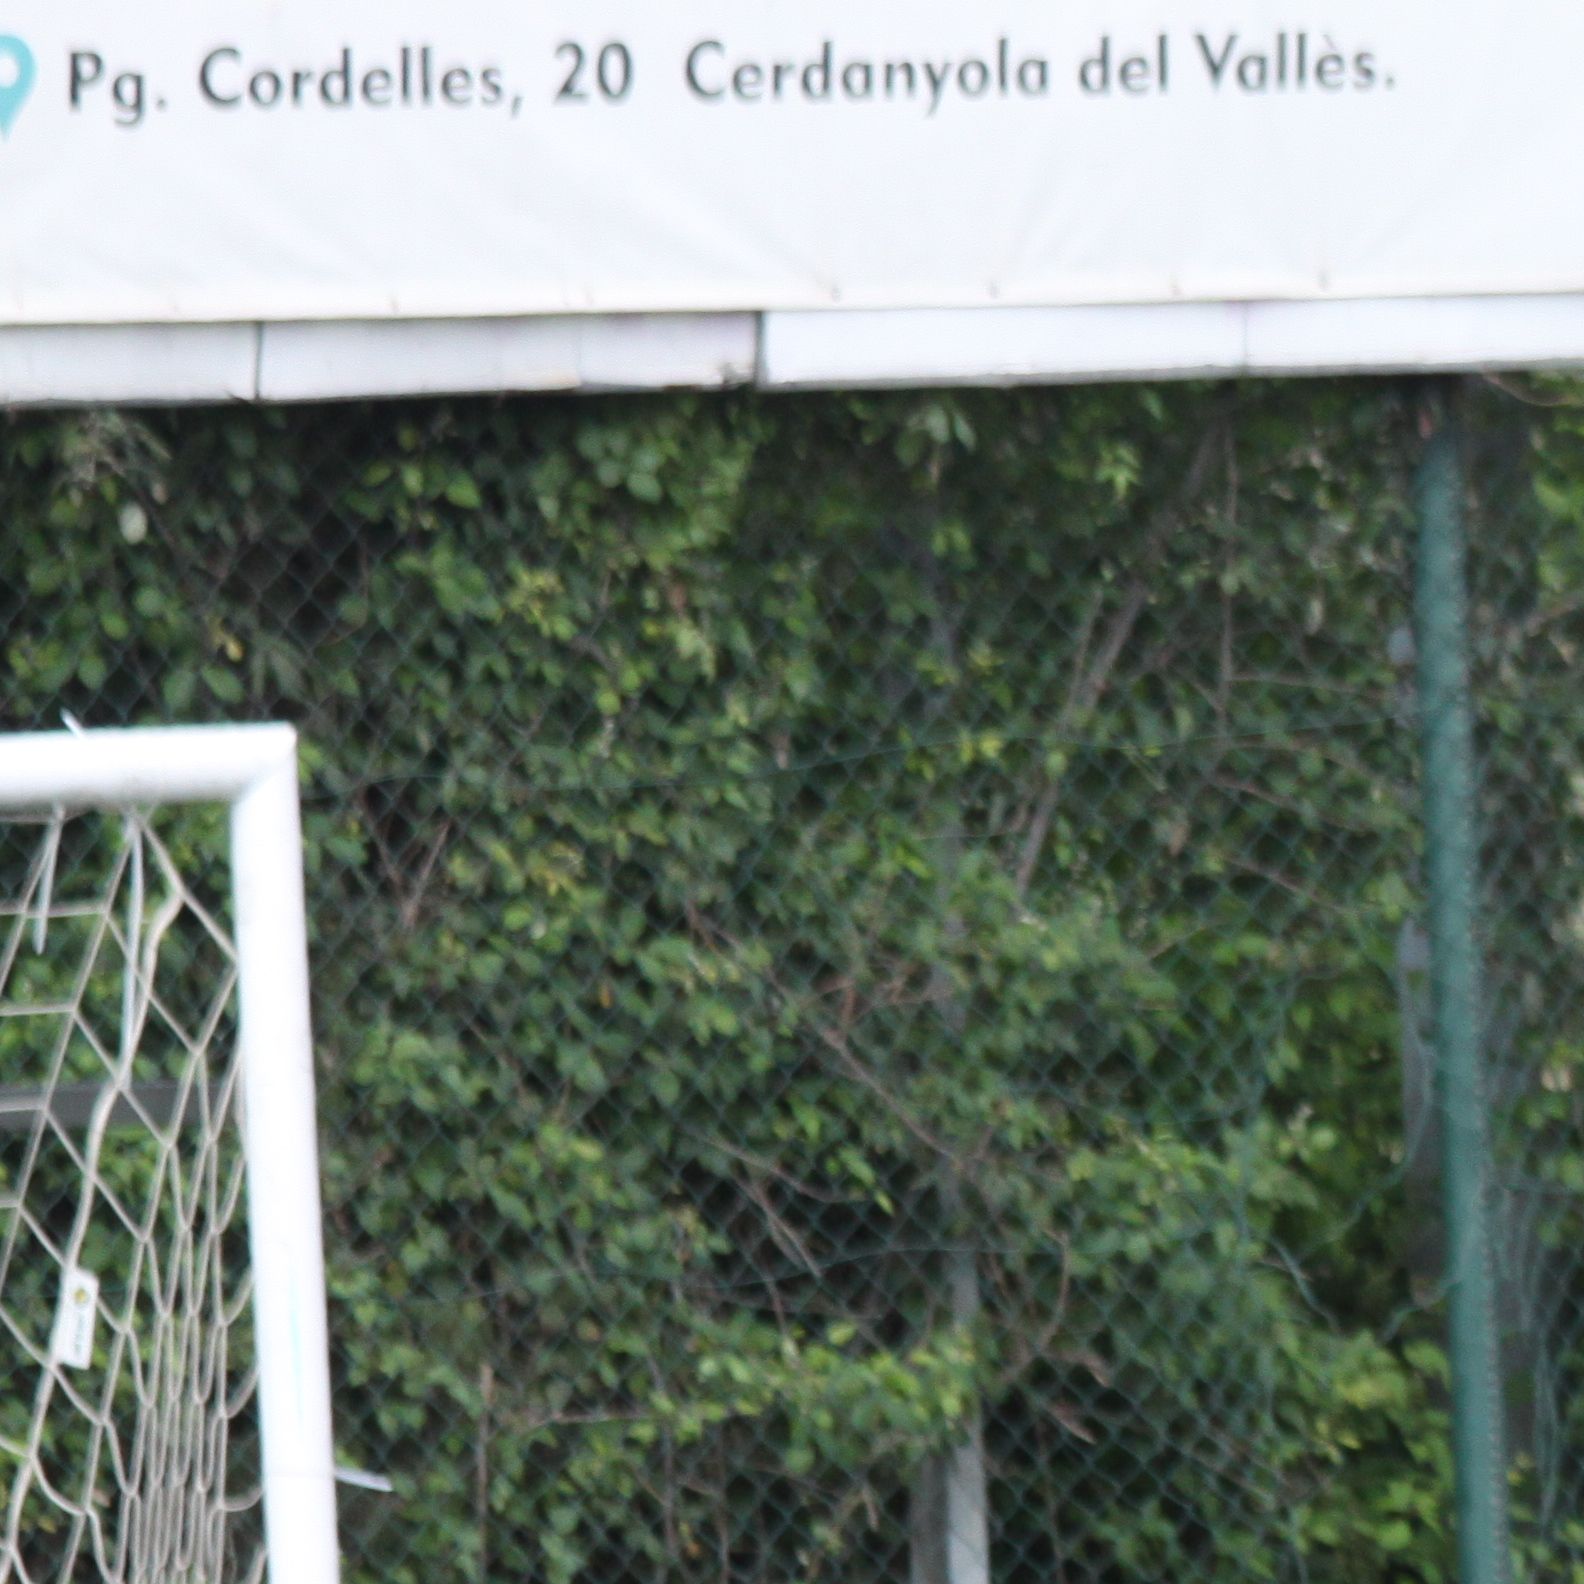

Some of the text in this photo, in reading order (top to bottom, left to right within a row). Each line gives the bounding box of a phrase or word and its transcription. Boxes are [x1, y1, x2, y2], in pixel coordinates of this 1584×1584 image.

[69, 32, 1395, 127] Pg. Cordelles, 20 Cerdanyola del Vallès.
